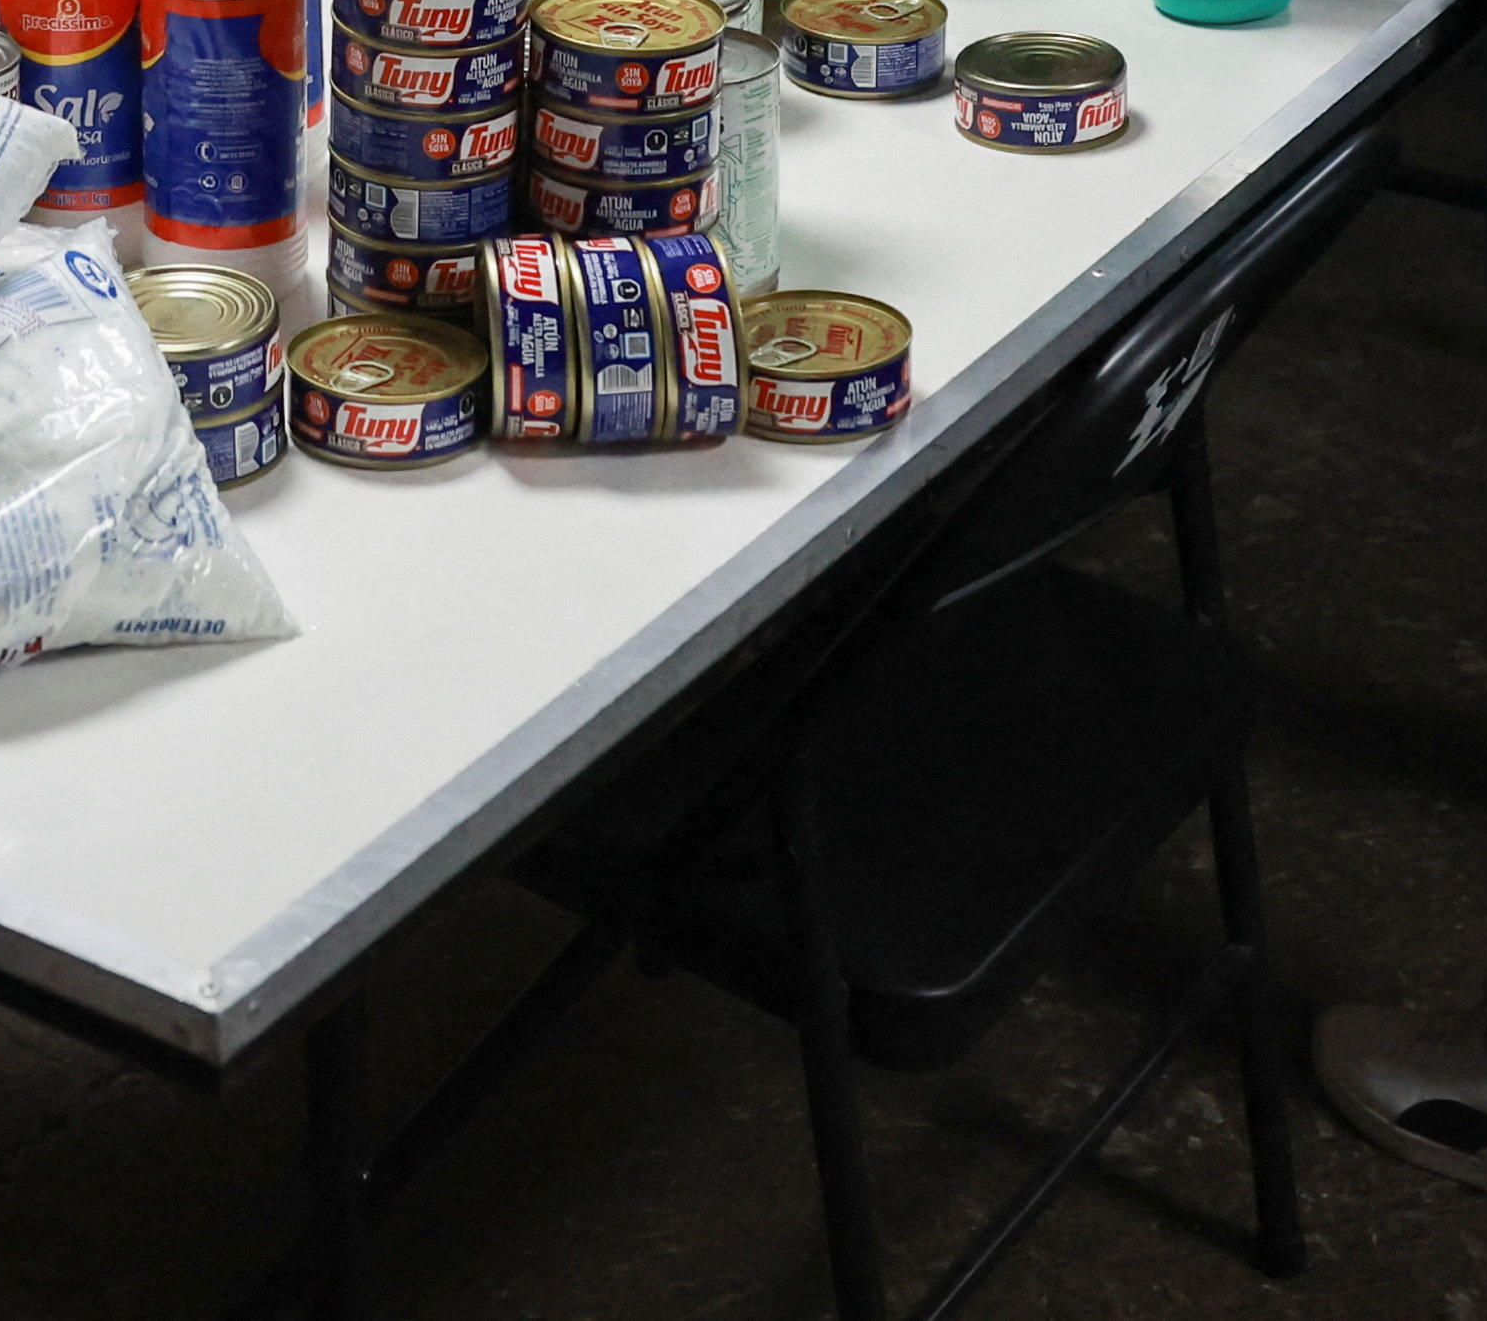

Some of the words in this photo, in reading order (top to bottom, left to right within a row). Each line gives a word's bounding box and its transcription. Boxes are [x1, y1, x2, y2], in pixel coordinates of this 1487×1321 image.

[598, 1, 632, 18] sin
[22, 13, 114, 31] precissimo
[381, 25, 415, 40] CLÁSICO
[470, 54, 498, 73] ATÚN
[623, 67, 641, 78] SIN
[378, 55, 453, 99] Tuny
[482, 72, 506, 90] AGUA
[562, 76, 589, 93] AGUA
[620, 78, 643, 88] SOYA
[665, 61, 716, 94] Tuny
[34, 84, 98, 128] Sal
[1079, 95, 1124, 130] Tuny
[1022, 112, 1050, 125] AGUA
[430, 133, 448, 145] SIN
[539, 110, 597, 164] Tuny
[1034, 130, 1064, 146] ATÚN
[451, 159, 484, 175] CLÁSICO
[613, 217, 645, 231] AGUA
[514, 241, 549, 298] Tuny
[542, 315, 559, 352] ATÚN
[520, 332, 536, 366] AGUA
[693, 306, 730, 382] Tuny
[847, 376, 877, 395] ATÚN
[755, 379, 828, 423] Tuny
[861, 396, 887, 414] AGUA
[343, 405, 421, 447] Tuny
